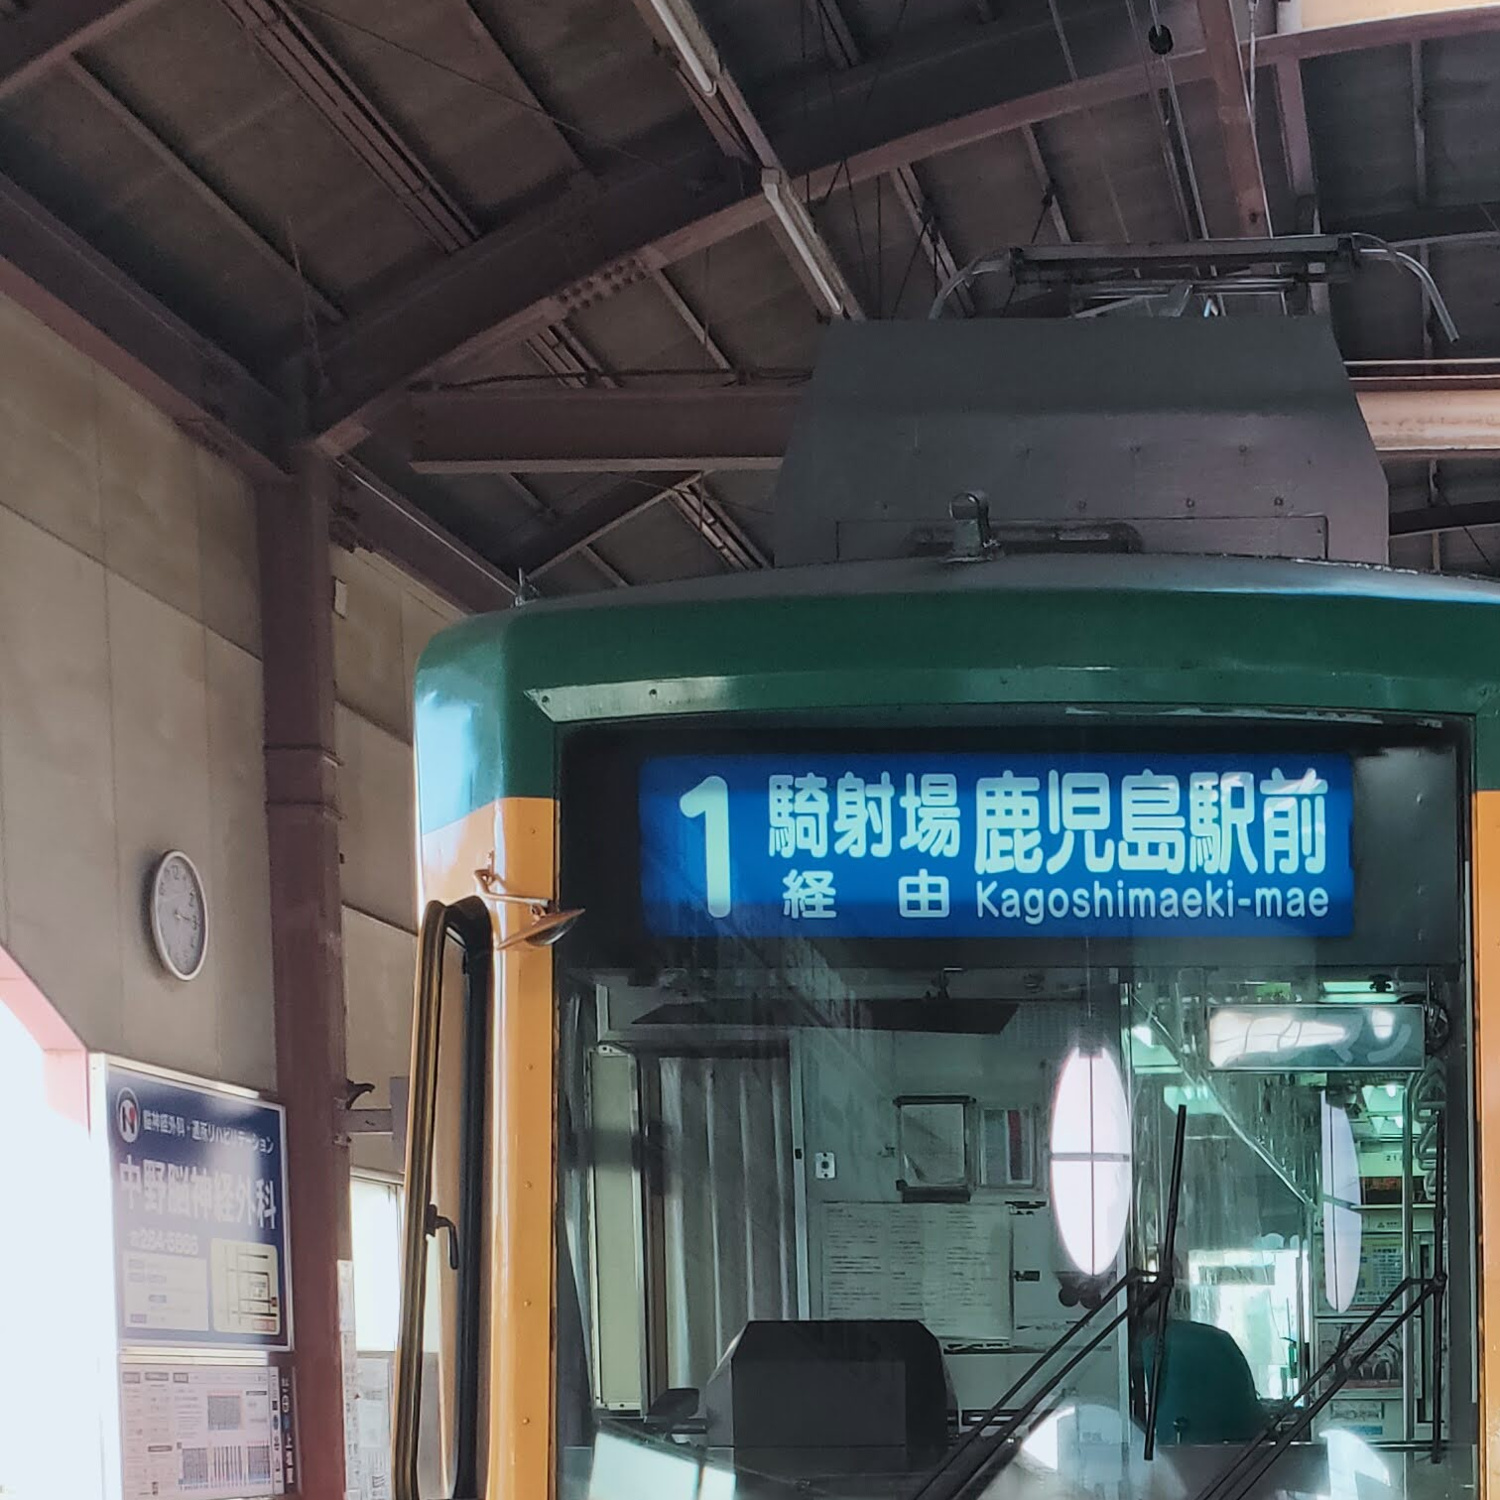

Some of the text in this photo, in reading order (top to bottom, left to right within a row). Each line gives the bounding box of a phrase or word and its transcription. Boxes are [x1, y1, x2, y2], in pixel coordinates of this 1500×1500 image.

[680, 768, 1329, 918] 1 騎射場 鹿児島駅前
[976, 880, 1329, 925] Kagoshimaeki-mae
